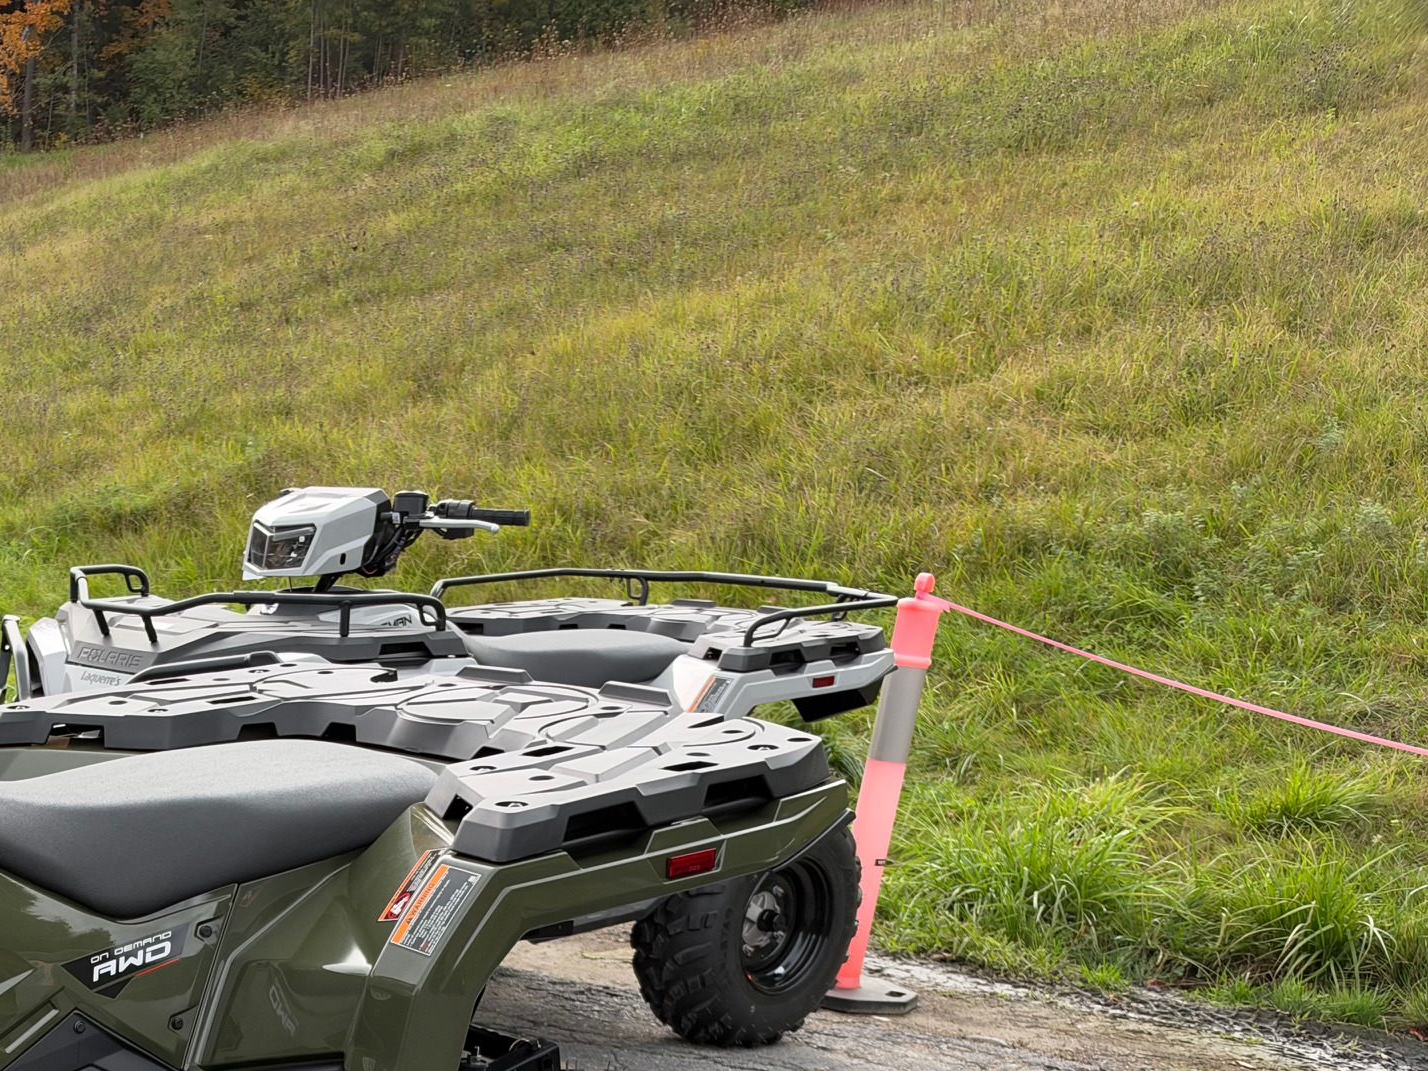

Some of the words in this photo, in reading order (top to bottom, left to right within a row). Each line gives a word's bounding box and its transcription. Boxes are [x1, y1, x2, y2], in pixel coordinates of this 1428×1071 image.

[77, 647, 144, 668] POLARIS
[80, 670, 122, 687] Laquerre's
[410, 883, 435, 920] WARNING
[90, 951, 110, 964] ON
[114, 930, 172, 956] DEMAND
[92, 940, 172, 983] AWD
